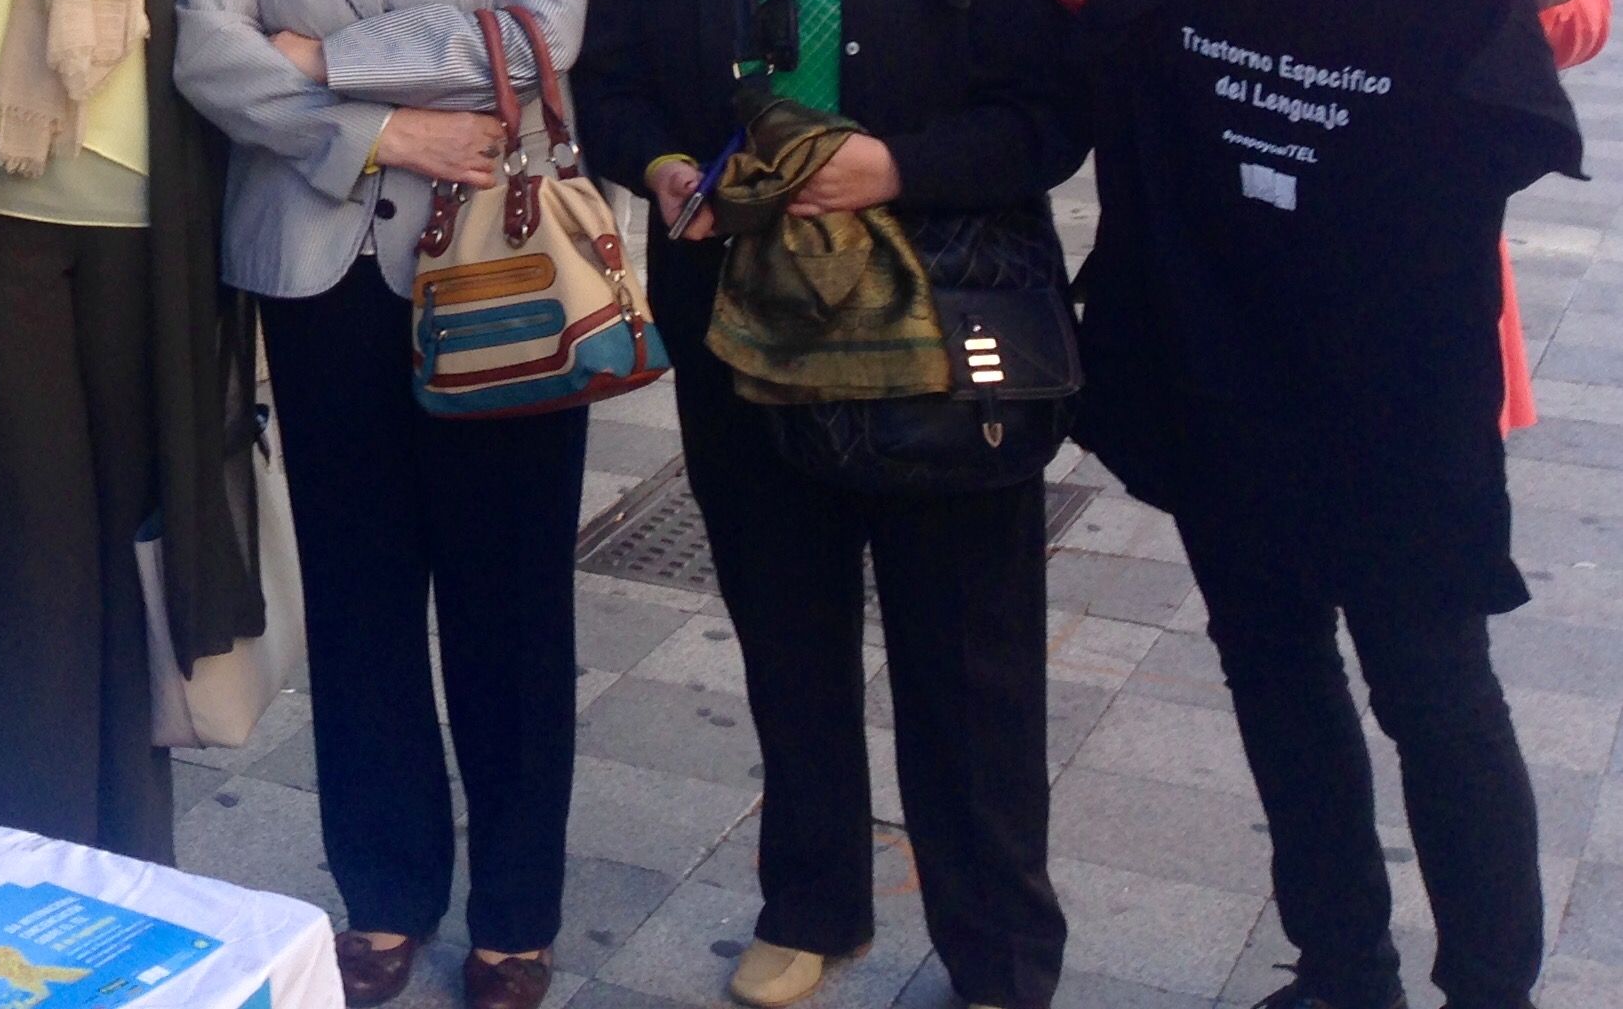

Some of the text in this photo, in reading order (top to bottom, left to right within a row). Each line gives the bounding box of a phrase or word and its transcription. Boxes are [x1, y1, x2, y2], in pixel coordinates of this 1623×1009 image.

[1181, 26, 1392, 95] Trastorno Específico
[1214, 75, 1351, 131] del Lenguaje
